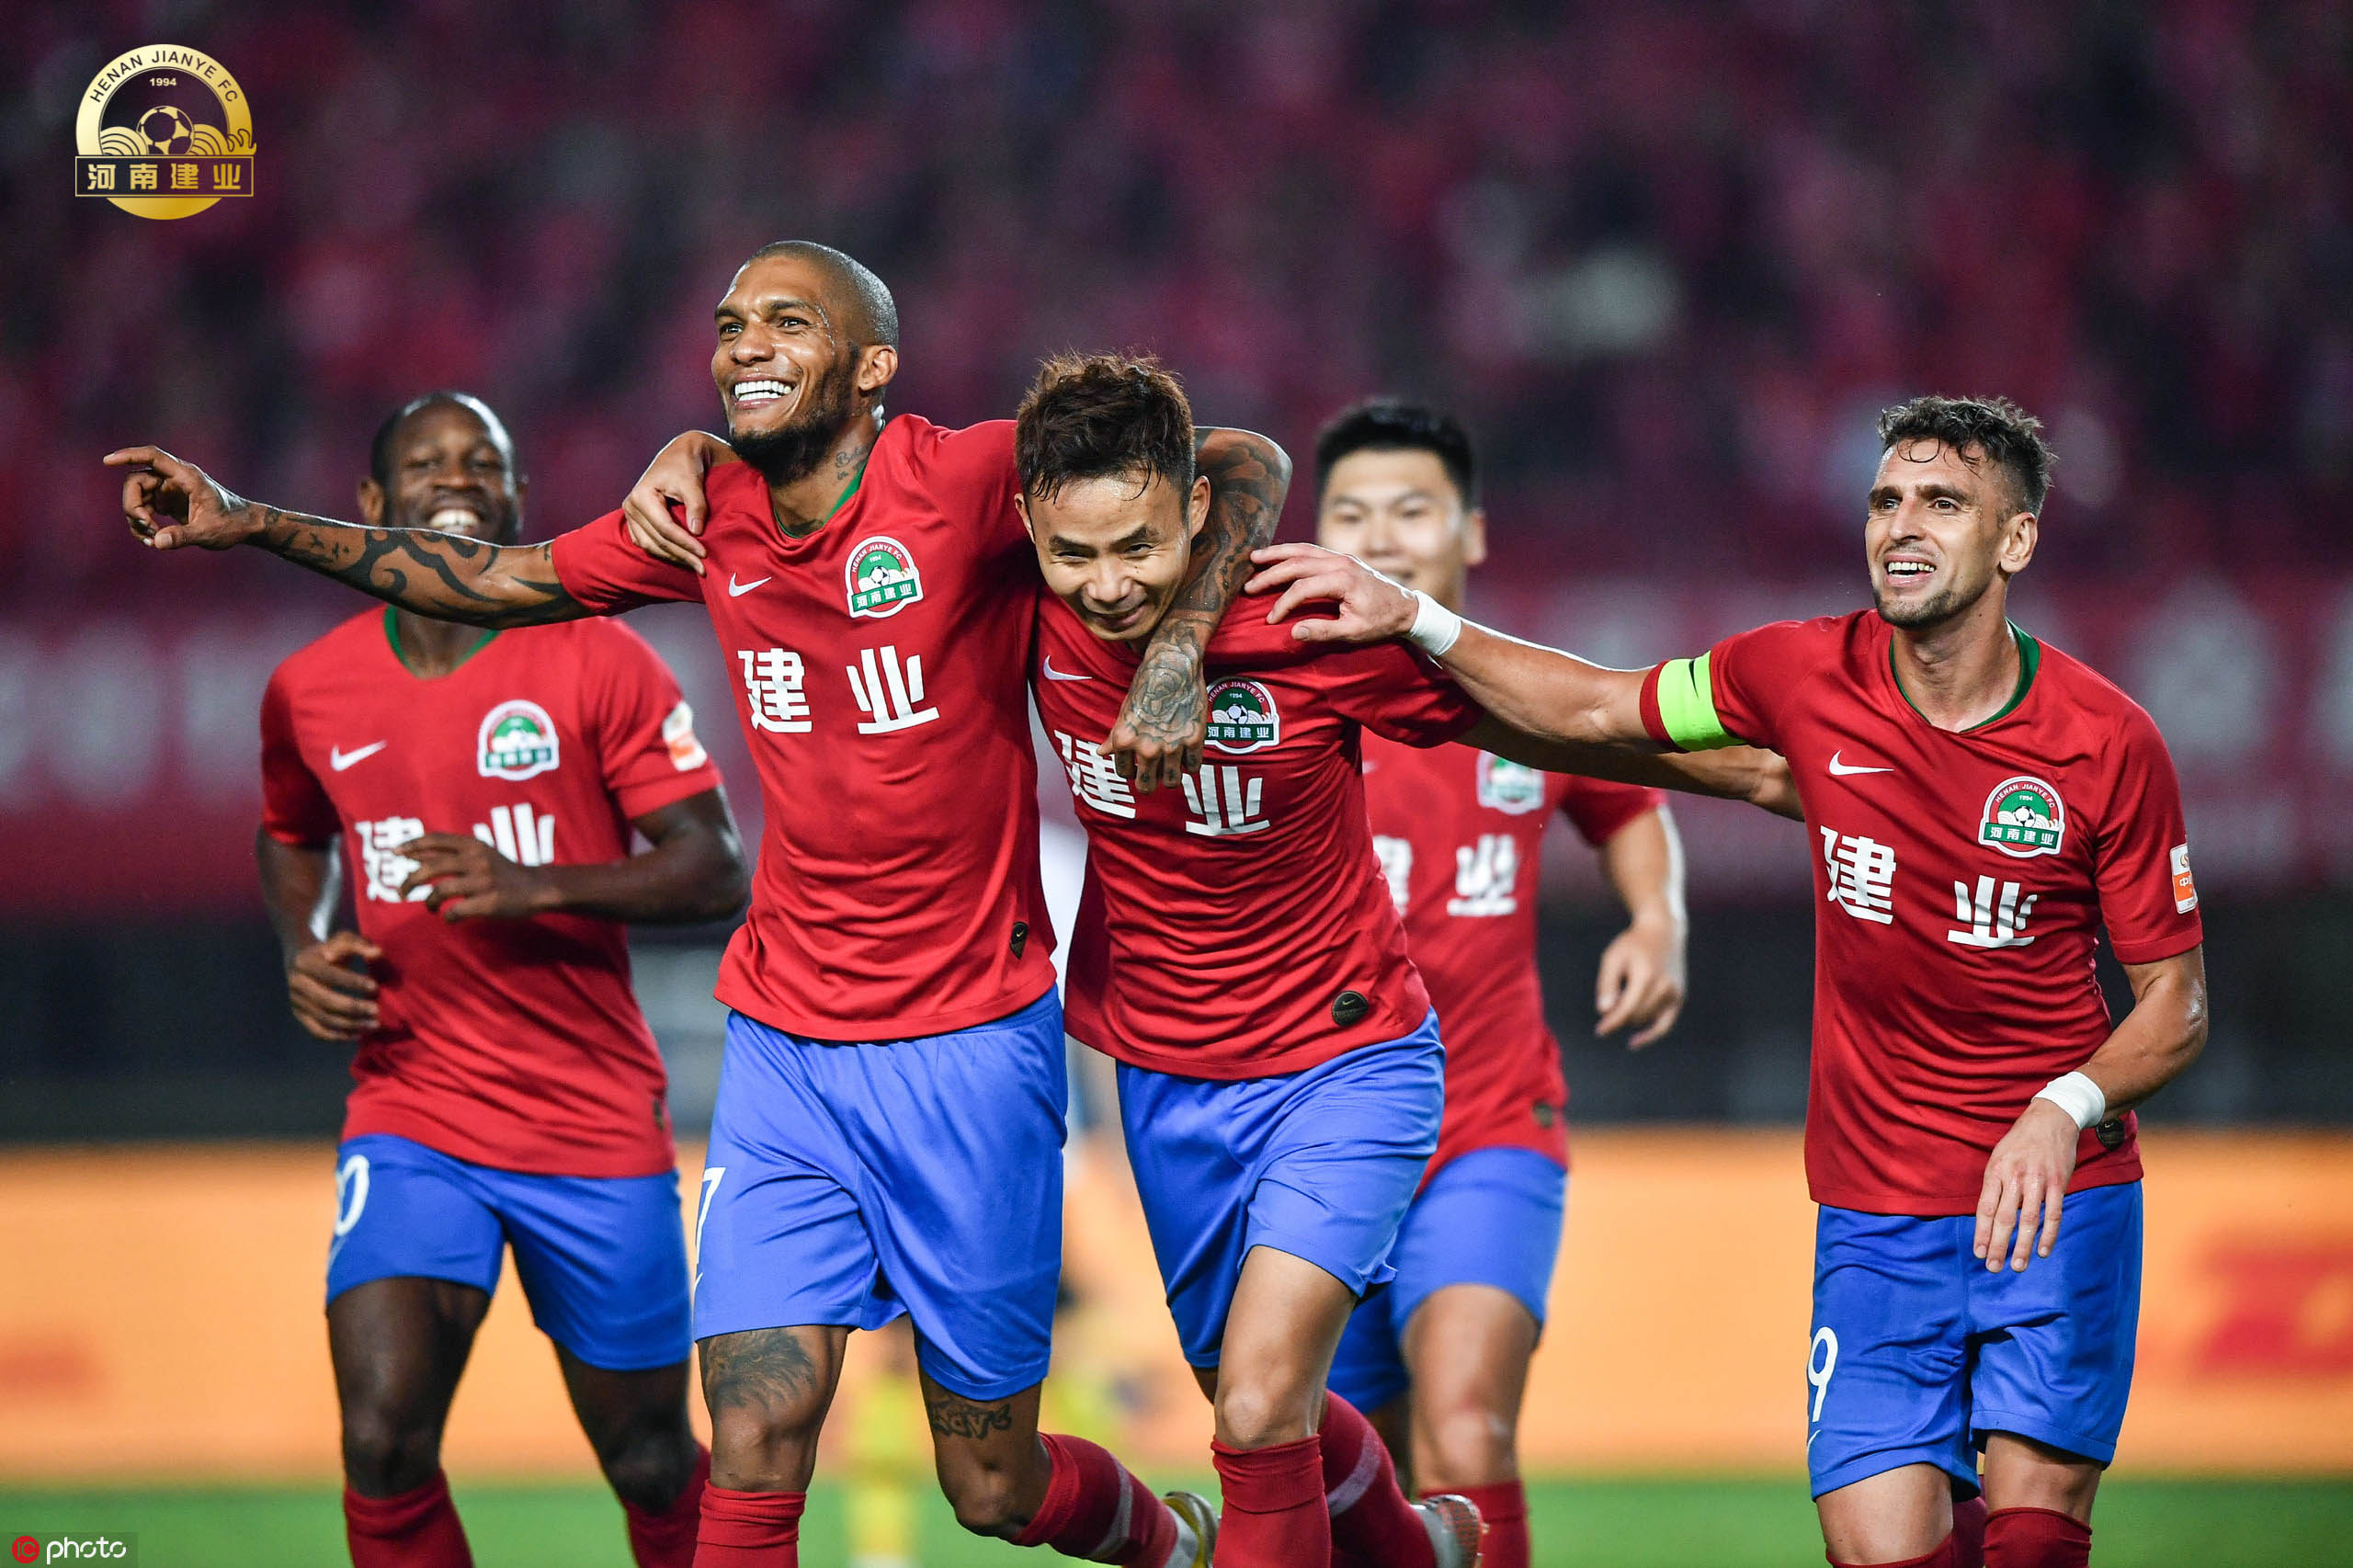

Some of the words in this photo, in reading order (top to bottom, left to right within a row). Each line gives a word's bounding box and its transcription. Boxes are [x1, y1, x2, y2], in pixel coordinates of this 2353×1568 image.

[737, 645, 940, 734] 建业
[1208, 683, 1228, 702] HENAN
[1230, 681, 1256, 694] JIANYE
[1207, 726, 1269, 738] 河南建业
[1054, 730, 1271, 837] 建业
[1995, 784, 2019, 803] HENAN
[2021, 783, 2048, 798] JIANYE
[1989, 826, 2054, 846] 河南建业
[1820, 824, 2038, 948] 建业
[1807, 1326, 1838, 1423] 9
